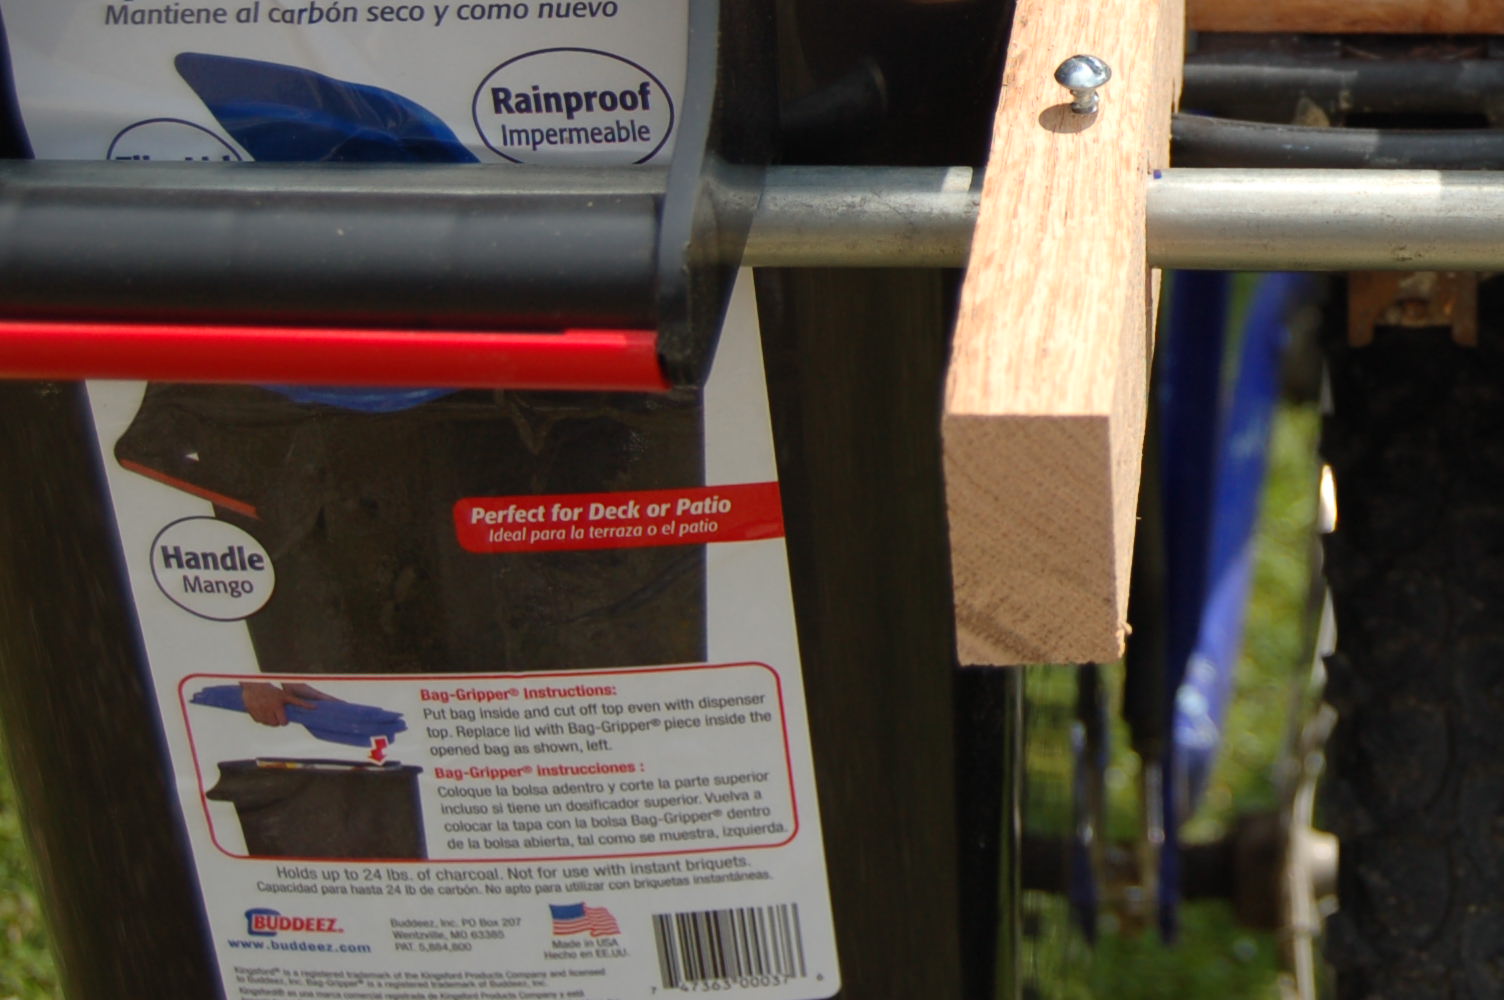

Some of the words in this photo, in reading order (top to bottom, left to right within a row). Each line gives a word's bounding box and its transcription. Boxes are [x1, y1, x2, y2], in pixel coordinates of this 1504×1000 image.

[105, 3, 227, 24] Mantiene
[235, 1, 259, 23] al
[267, 1, 357, 24] carbón
[366, 5, 424, 21] seco
[433, 4, 449, 25] y
[456, 3, 528, 20] como
[537, 1, 618, 18] nuevo
[490, 81, 656, 117] Rainproof
[496, 120, 650, 151] Impermeable
[470, 505, 544, 524] Perfect
[551, 503, 583, 521] for
[588, 500, 639, 520] Deck
[645, 503, 670, 517] or
[676, 494, 731, 516] Patio
[488, 527, 526, 542] Ideal
[529, 529, 565, 543] para
[570, 525, 584, 539] la
[588, 526, 642, 538] terraza
[646, 525, 657, 535] o
[661, 520, 675, 535] el
[678, 518, 717, 536] patio
[160, 545, 266, 571] Handle
[182, 575, 253, 597] Mango
[422, 708, 446, 720] Put
[449, 708, 476, 721] bag
[479, 707, 519, 719] inside
[523, 705, 549, 719] and
[553, 705, 575, 717] cut
[578, 703, 597, 715] off
[601, 703, 623, 716] top
[627, 702, 660, 713] even
[664, 698, 694, 711] with
[697, 695, 765, 712] dispenser
[425, 726, 452, 739] top.
[455, 725, 509, 739] Replace
[513, 725, 530, 737] lid
[534, 723, 564, 736] with
[567, 718, 661, 735] Bag-Gripper®
[663, 718, 700, 731] piece
[704, 713, 745, 726] inside
[748, 711, 771, 722] the
[429, 743, 480, 757] opened
[483, 743, 509, 756] bag
[513, 745, 530, 754] as
[533, 742, 583, 753] shown,
[585, 739, 611, 751] left.
[436, 786, 491, 798] Coloque
[495, 785, 508, 796] la
[511, 784, 548, 796] bolsa
[551, 782, 604, 795] adentro
[607, 783, 615, 794] y
[618, 779, 654, 791] corte
[657, 778, 671, 789] la
[674, 776, 709, 790] parte
[713, 772, 768, 791] superior
[440, 803, 488, 815] incluso
[491, 802, 503, 814] si
[506, 802, 540, 814] tiene
[544, 802, 561, 813] un
[565, 798, 639, 811] dosificador
[643, 795, 701, 808] superior.
[703, 791, 749, 803] Vuelva
[753, 790, 762, 800] a
[276, 866, 317, 884] Holds
[321, 870, 340, 882] up
[343, 868, 358, 885] to
[362, 868, 382, 881] 24
[385, 868, 412, 886] lbs.
[416, 868, 430, 886] of
[434, 868, 502, 885] charcoal.
[506, 867, 533, 880] Not
[536, 866, 556, 879] for
[562, 867, 589, 883] use
[592, 864, 626, 876] with
[629, 860, 681, 881] instant
[684, 856, 755, 877] briquets.
[227, 940, 370, 952] www.buddeez.com
[551, 939, 581, 949] Made
[596, 938, 619, 949] USA
